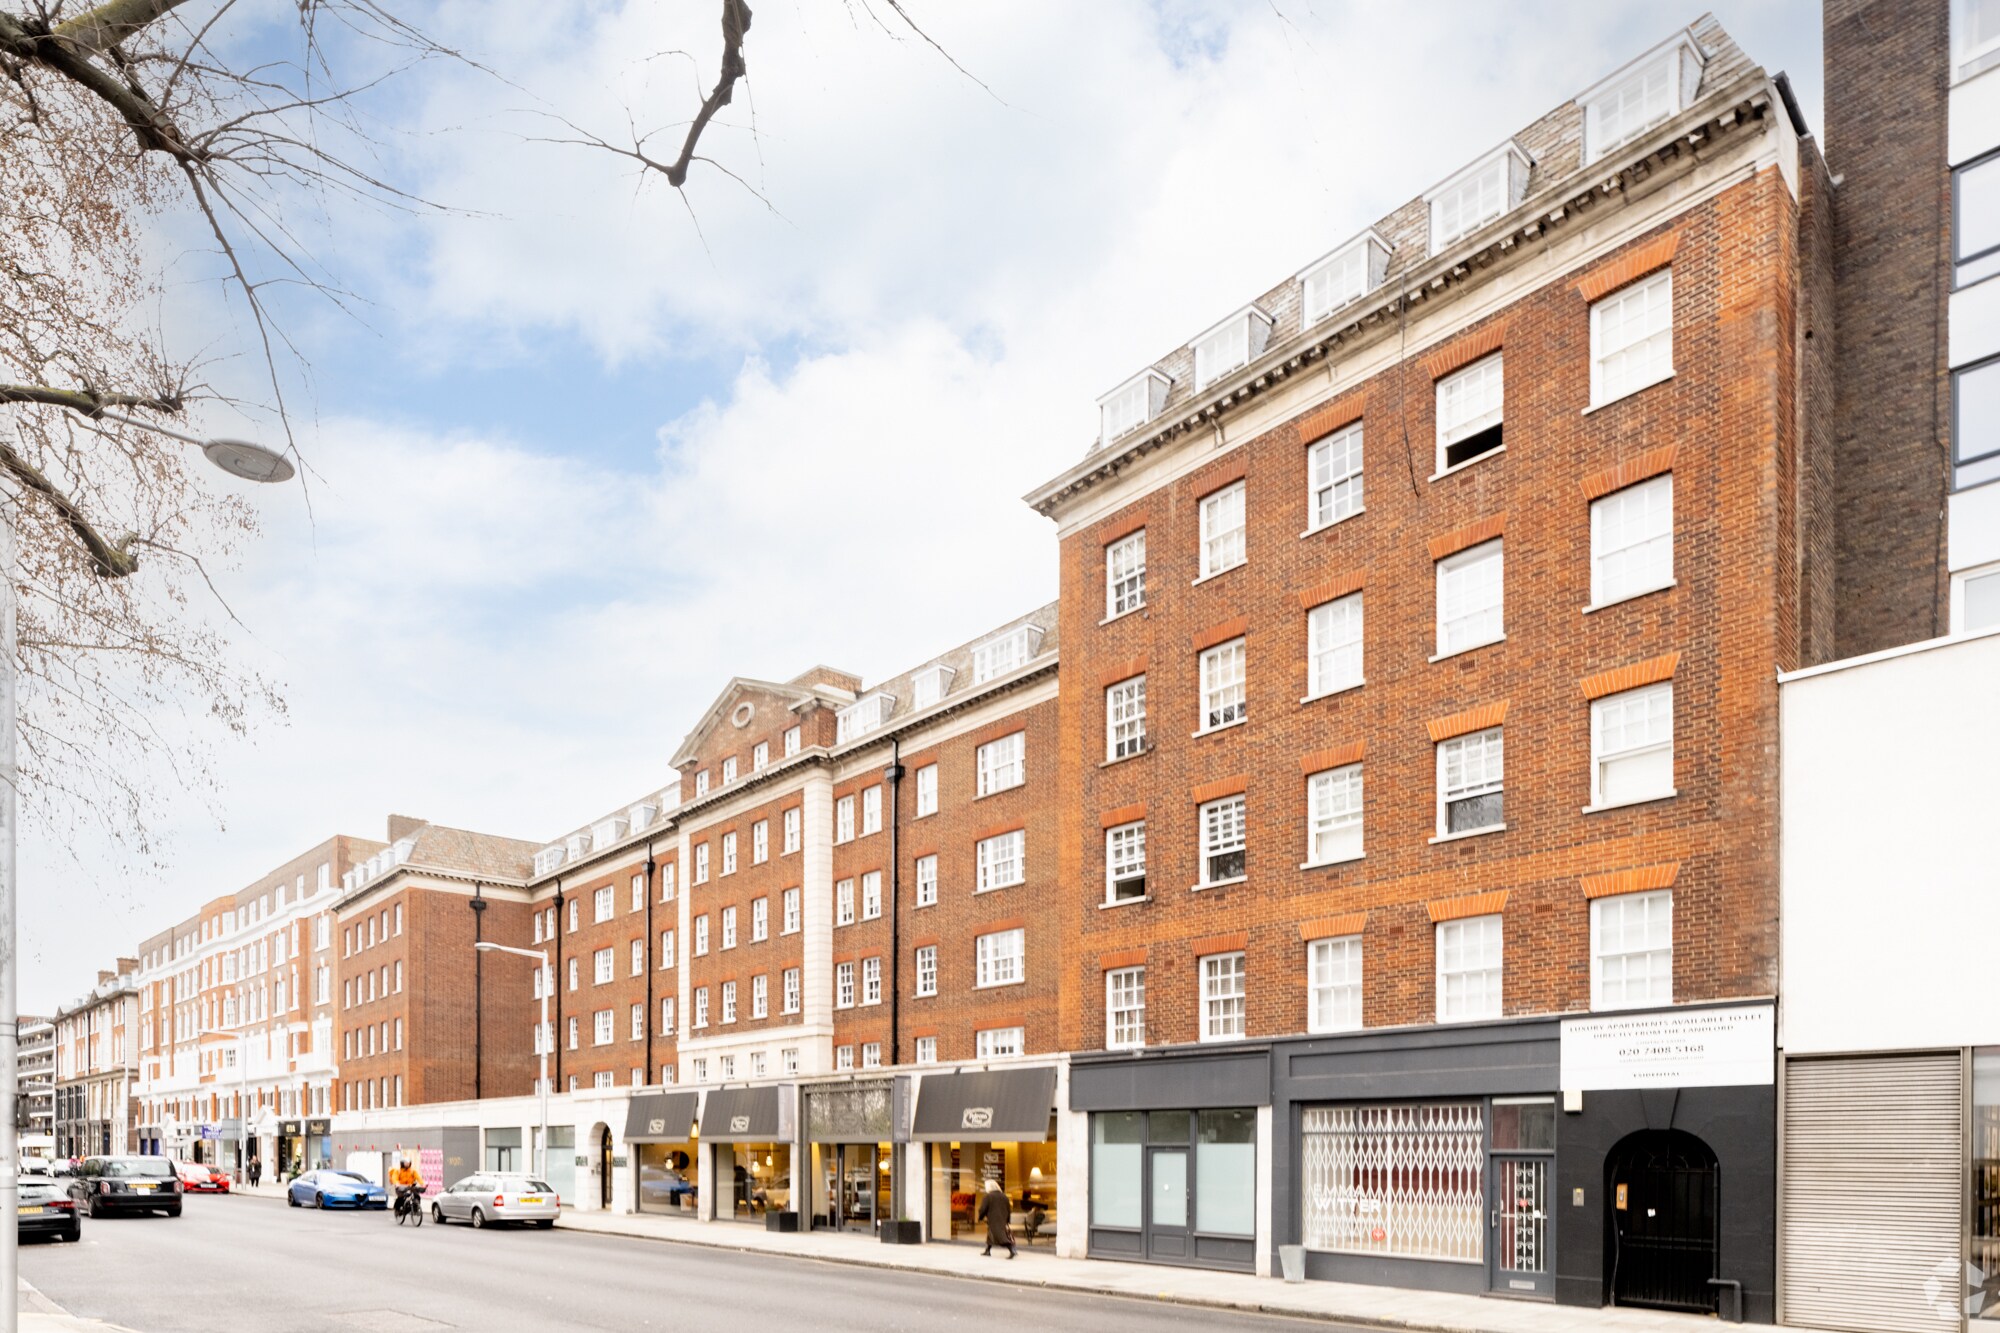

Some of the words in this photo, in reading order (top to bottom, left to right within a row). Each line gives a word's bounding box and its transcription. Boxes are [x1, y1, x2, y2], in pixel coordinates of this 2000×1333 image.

[1569, 1024, 1605, 1032] LUXURY
[1607, 1021, 1669, 1030] APARTMENTS
[1671, 1016, 1725, 1025] AVAILABLE
[1729, 1014, 1742, 1022] TO
[1744, 1013, 1762, 1021] LET
[1593, 1031, 1633, 1039] DIRECTLY
[1682, 1025, 1735, 1034] LANDLORD
[1618, 1048, 1640, 1056] 020
[1643, 1045, 1672, 1055] 7408
[1675, 1044, 1705, 1053] 5168
[1314, 1183, 1365, 1198] EMMA
[1314, 1197, 1381, 1213] WITTER
